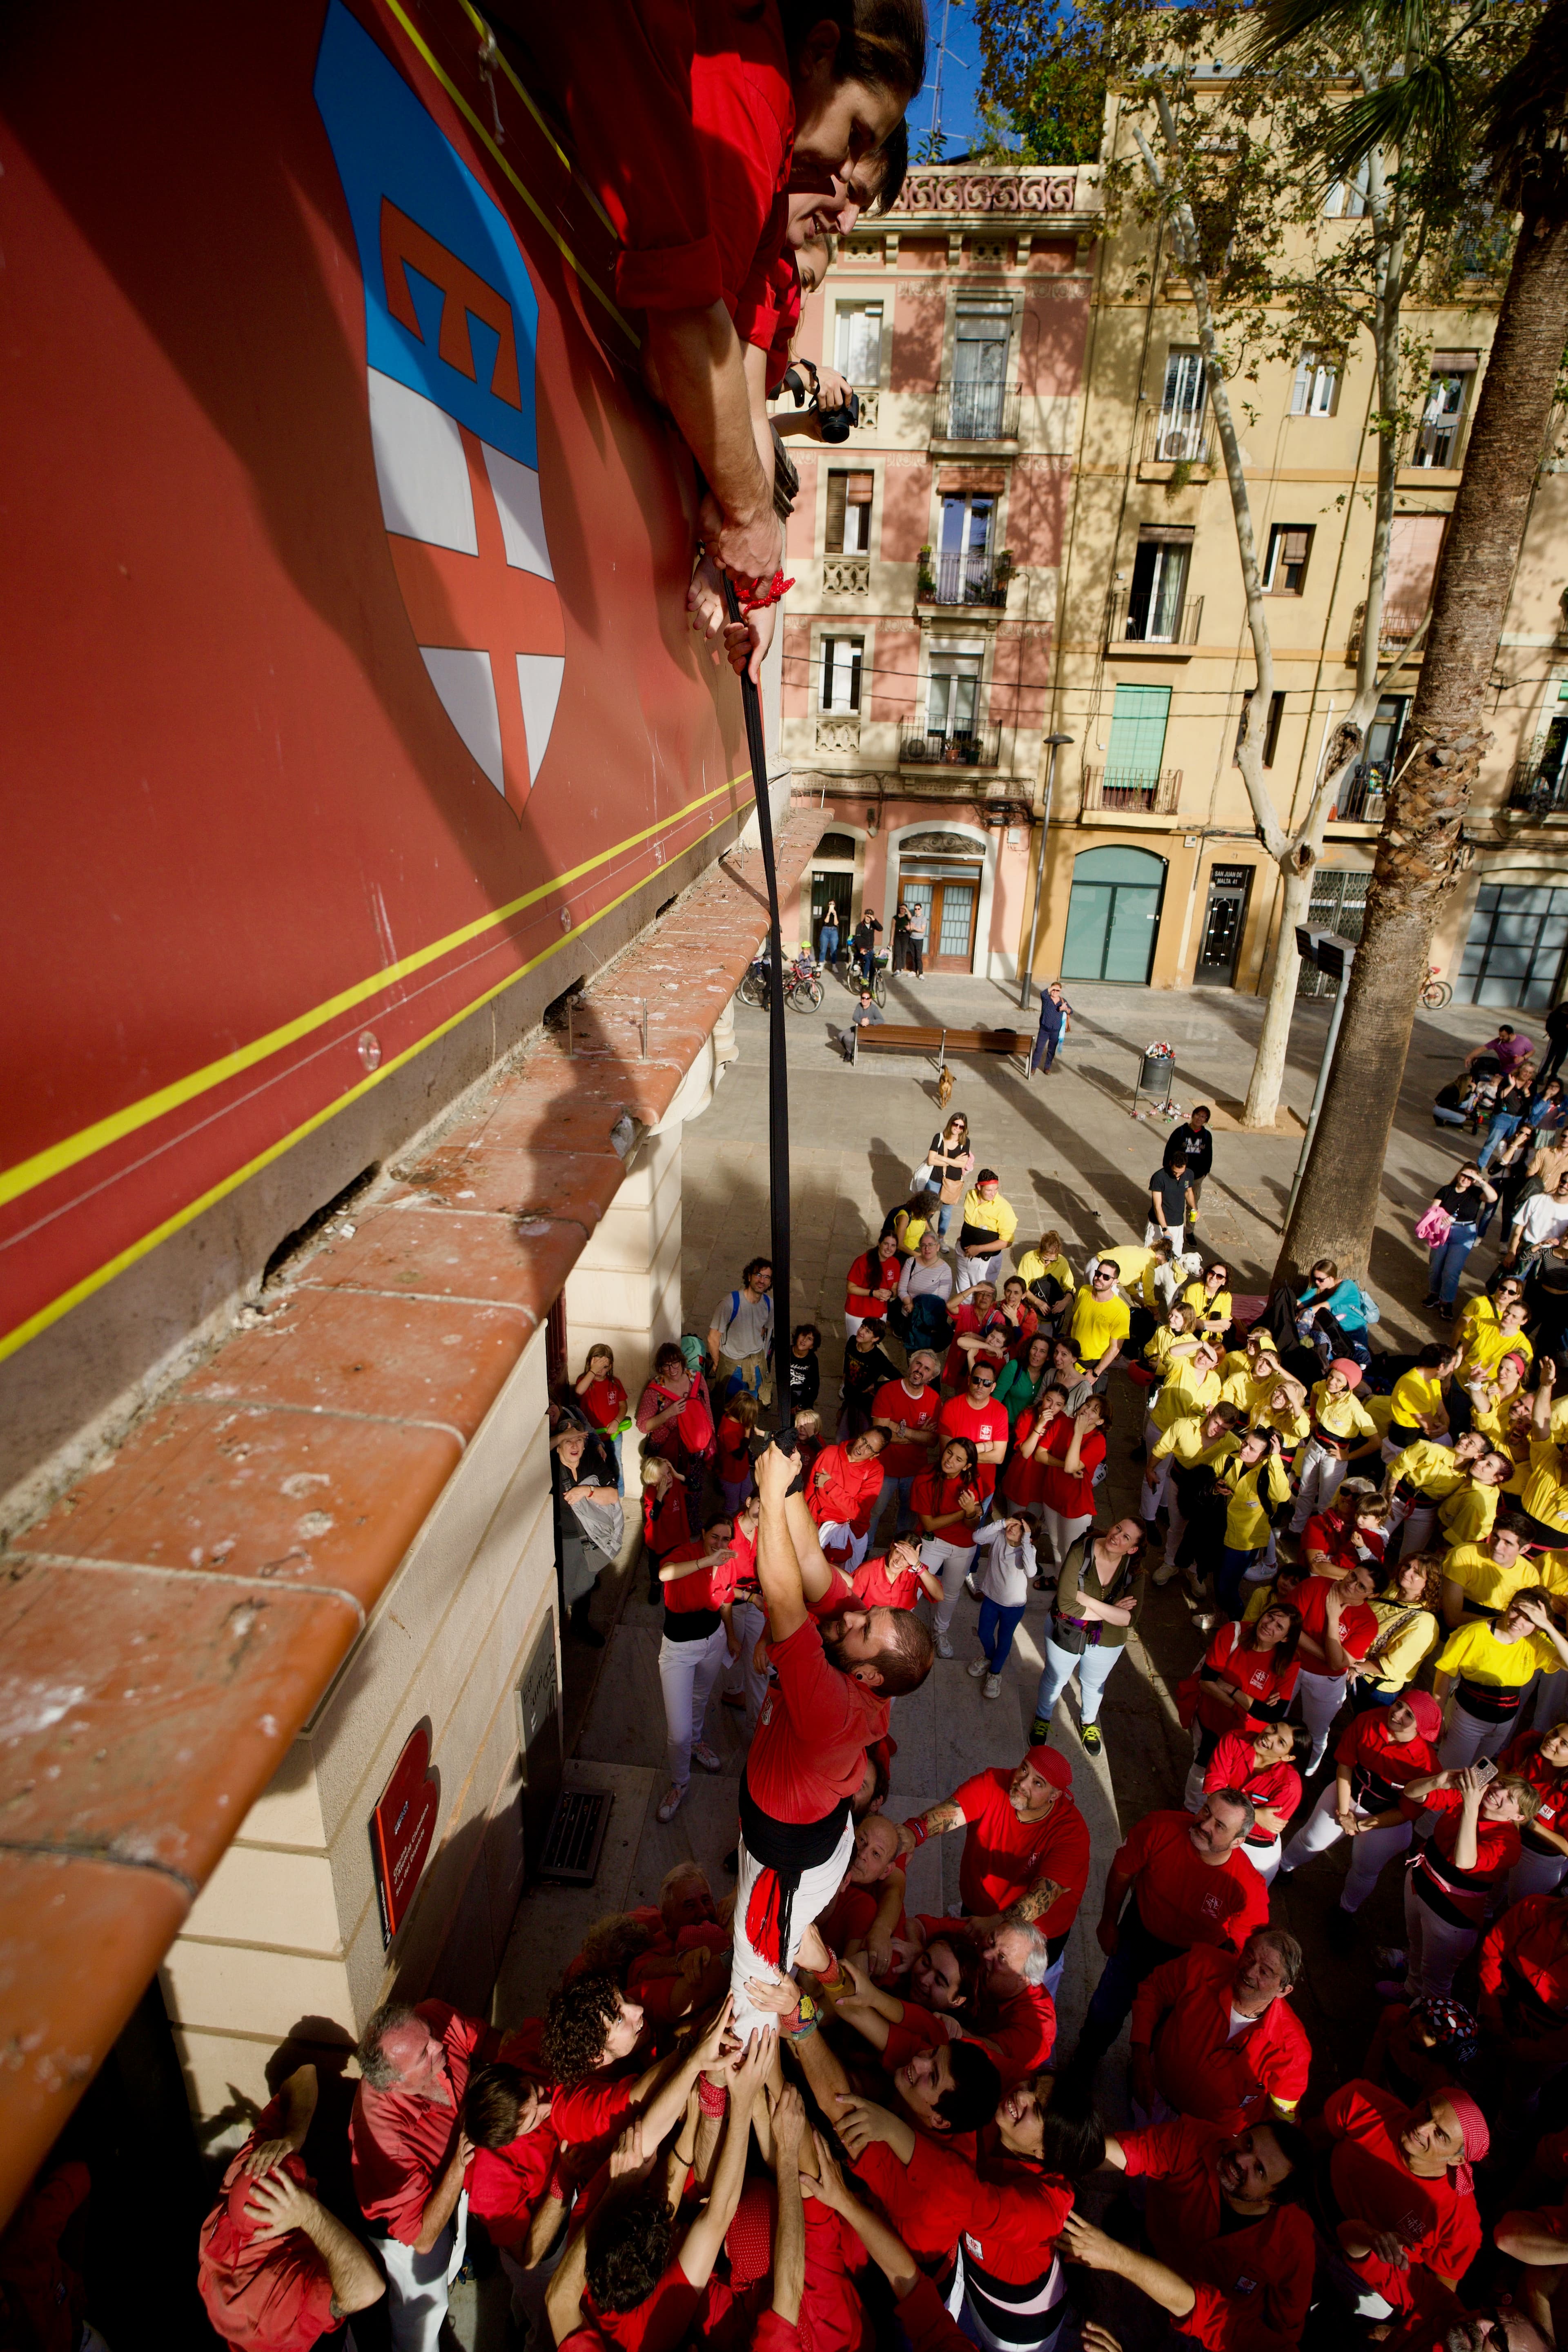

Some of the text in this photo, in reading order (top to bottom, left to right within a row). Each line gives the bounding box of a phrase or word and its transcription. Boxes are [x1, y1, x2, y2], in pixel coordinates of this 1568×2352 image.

[412, 1803, 429, 1843] Ciutadana
[394, 1846, 407, 1877] Oficina
[410, 1829, 425, 1863] Districte
